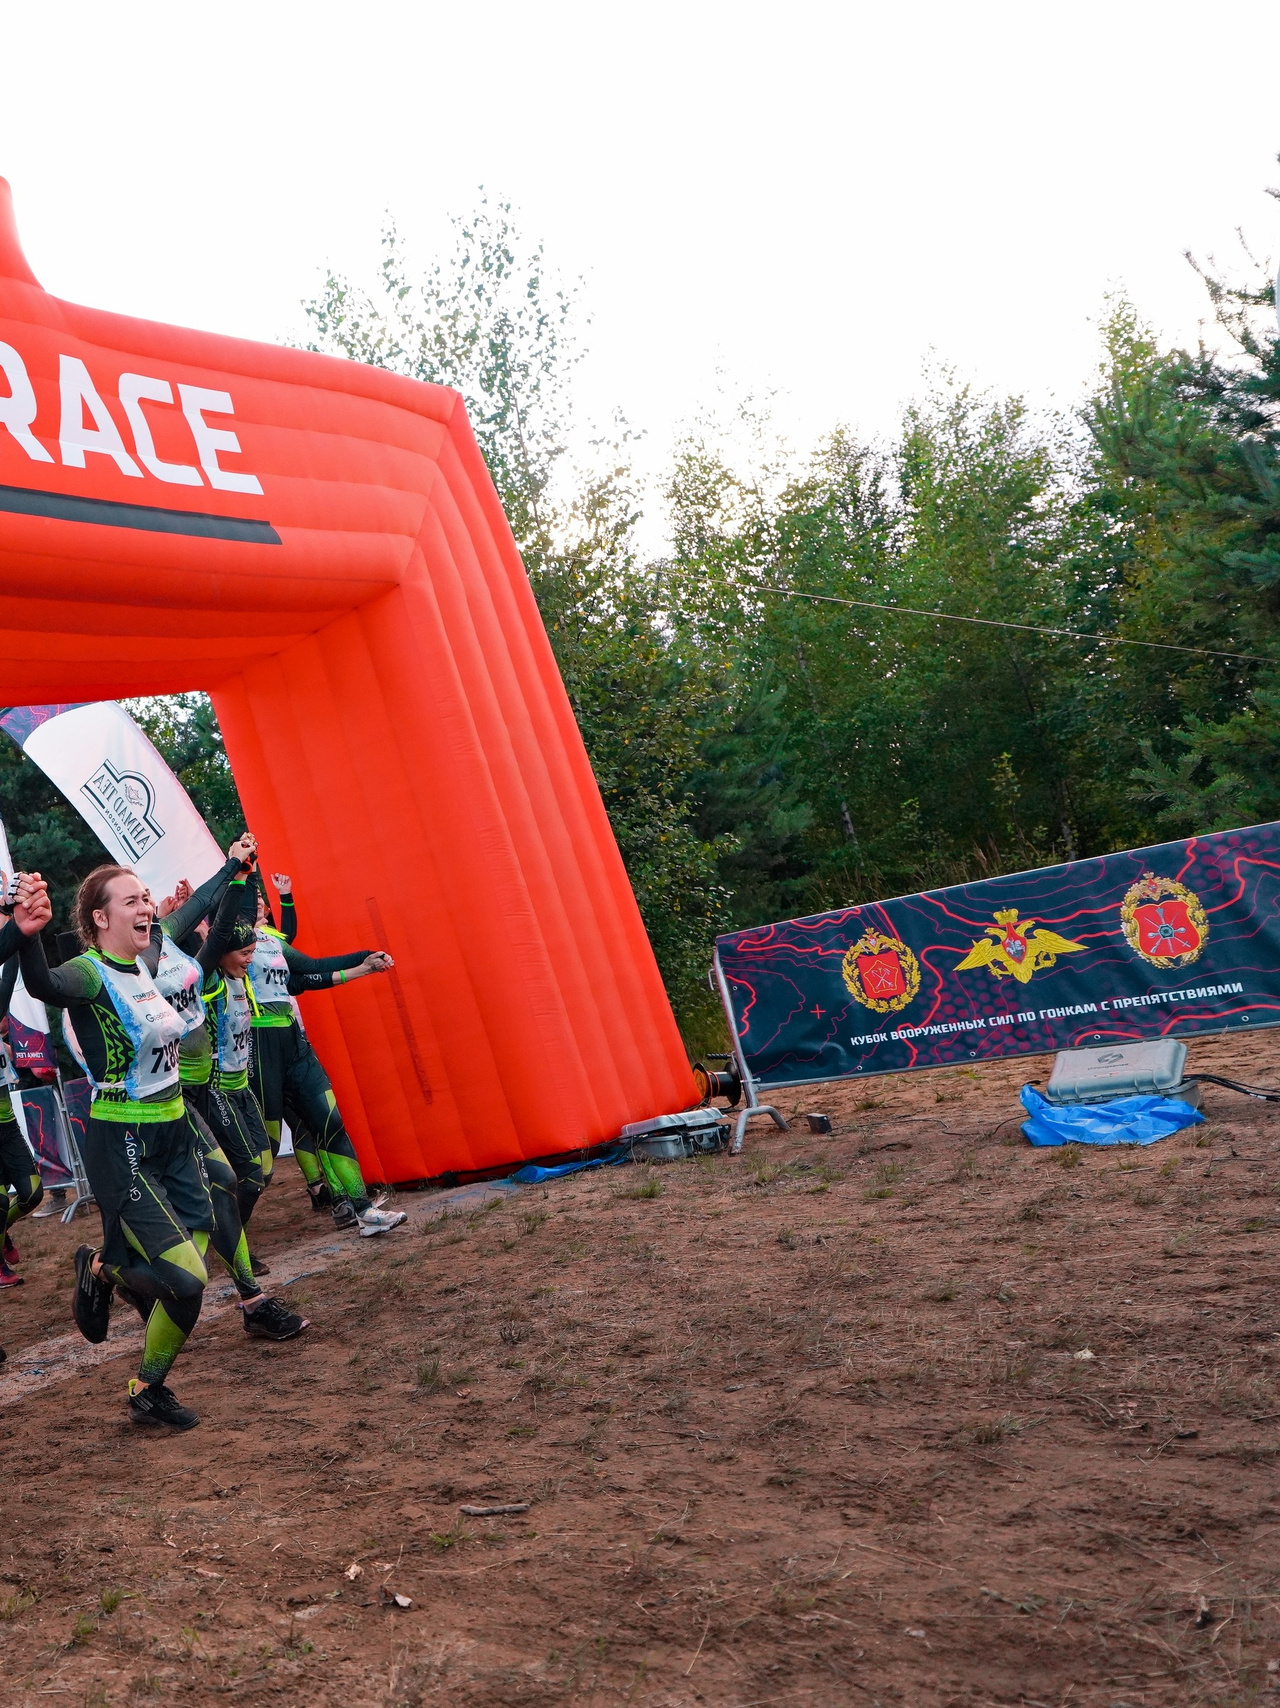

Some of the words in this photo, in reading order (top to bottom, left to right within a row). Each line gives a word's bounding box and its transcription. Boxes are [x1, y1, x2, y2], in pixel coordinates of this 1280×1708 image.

[850, 1032, 888, 1046] КУБОК
[891, 1018, 986, 1040] ВООРУЖЕННЫХ
[989, 1014, 1015, 1026] СИЛ
[1017, 1010, 1036, 1022] ПО
[1039, 1002, 1098, 1020] ГОНКАМ
[1101, 1001, 1111, 1011] С
[1113, 982, 1244, 1009] ПРЕПЯТСТВИЯМИ
